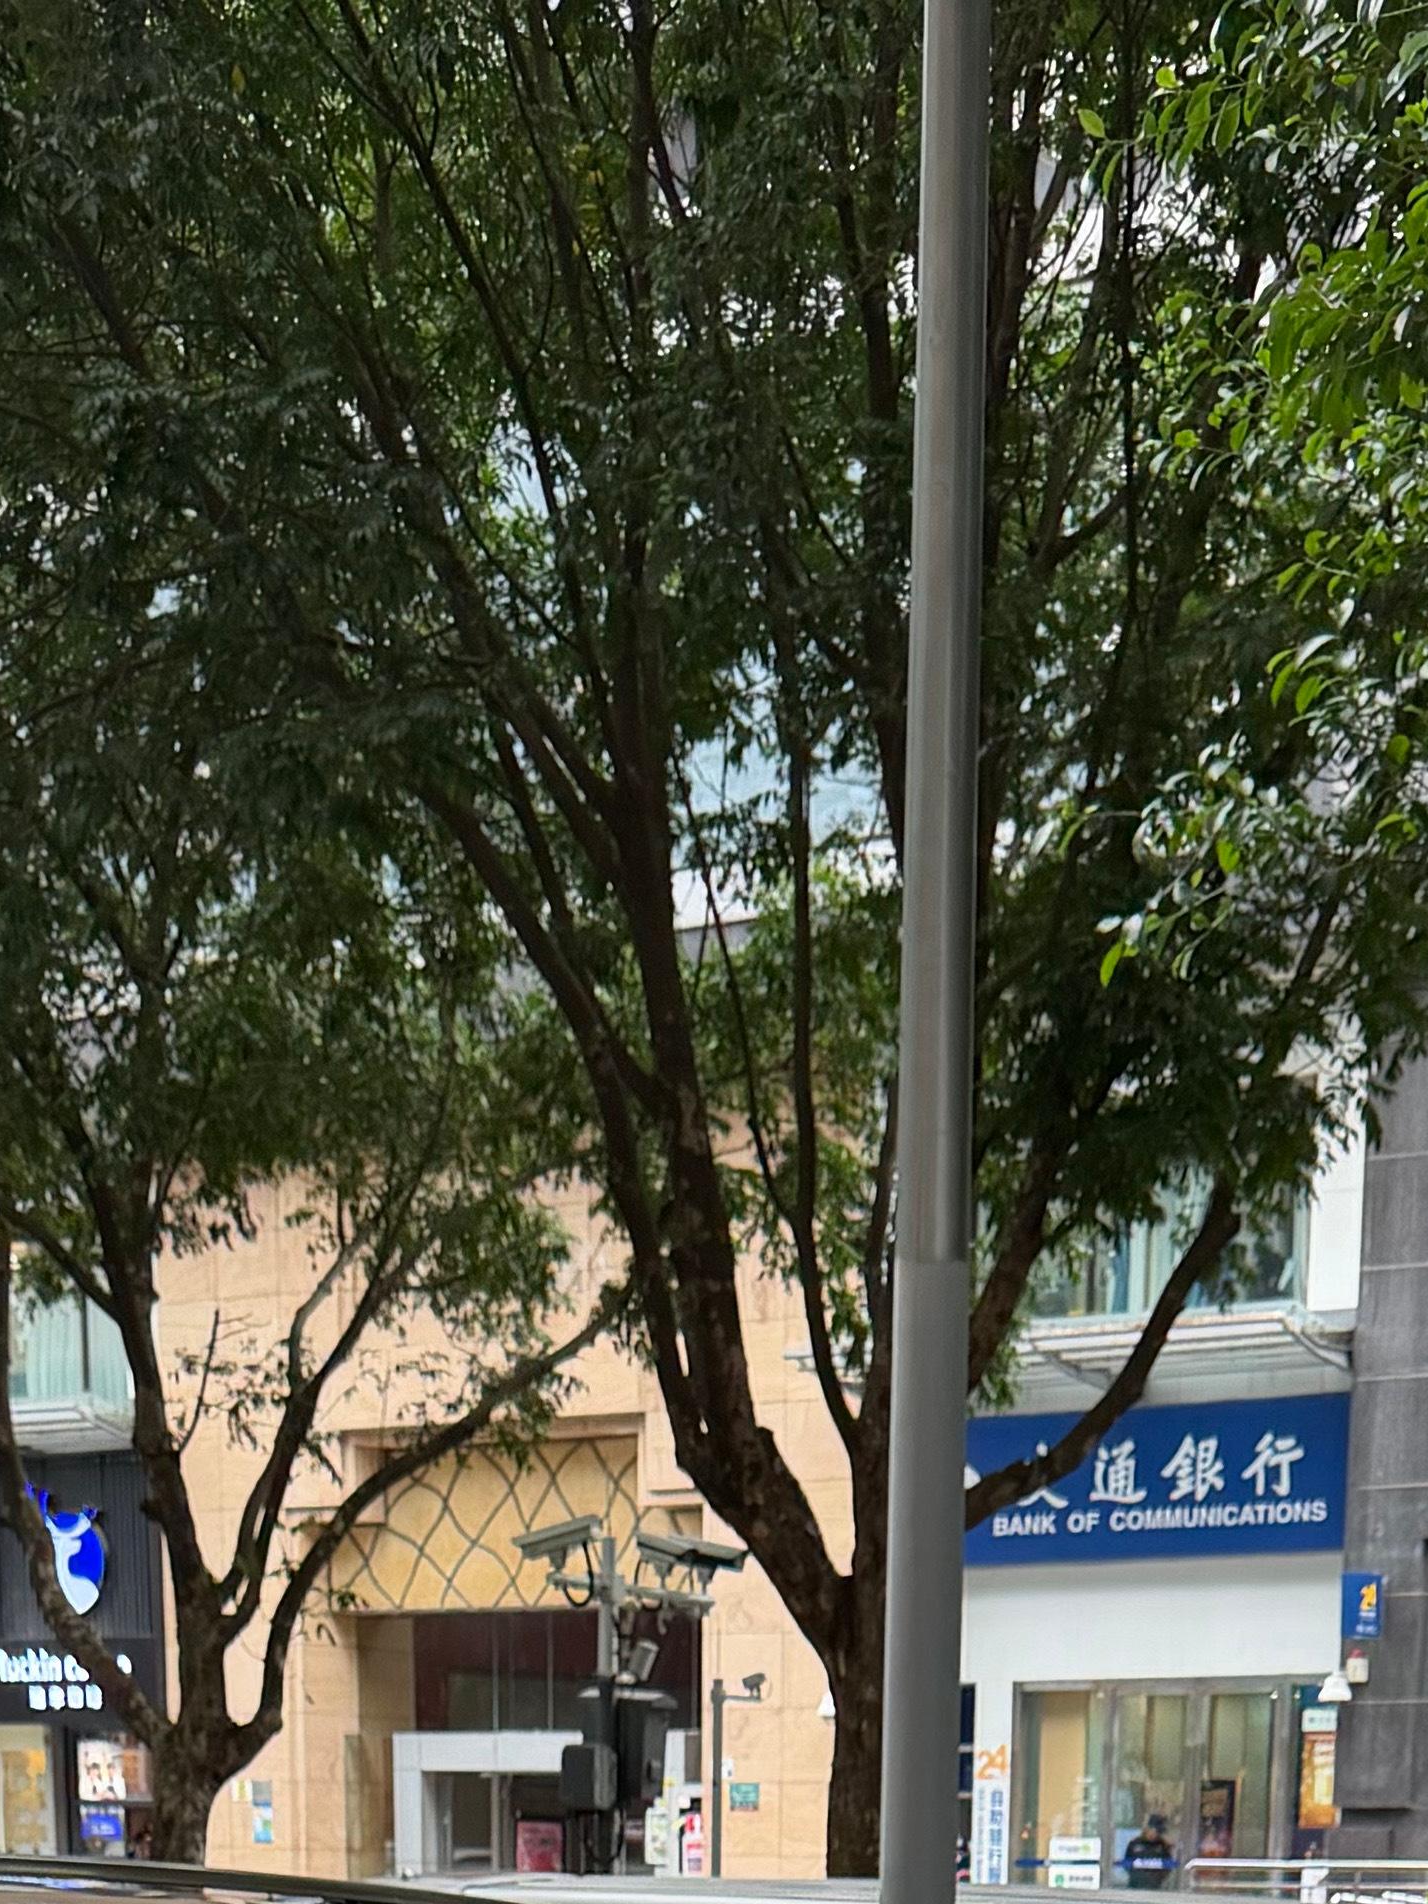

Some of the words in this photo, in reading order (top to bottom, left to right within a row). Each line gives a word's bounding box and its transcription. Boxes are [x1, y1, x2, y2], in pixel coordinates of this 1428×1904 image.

[992, 1513, 1057, 1538] BANK
[1067, 1510, 1100, 1534] OF
[1109, 1498, 1328, 1533] COMMUNICATIONS
[976, 1743, 1009, 1780] 24
